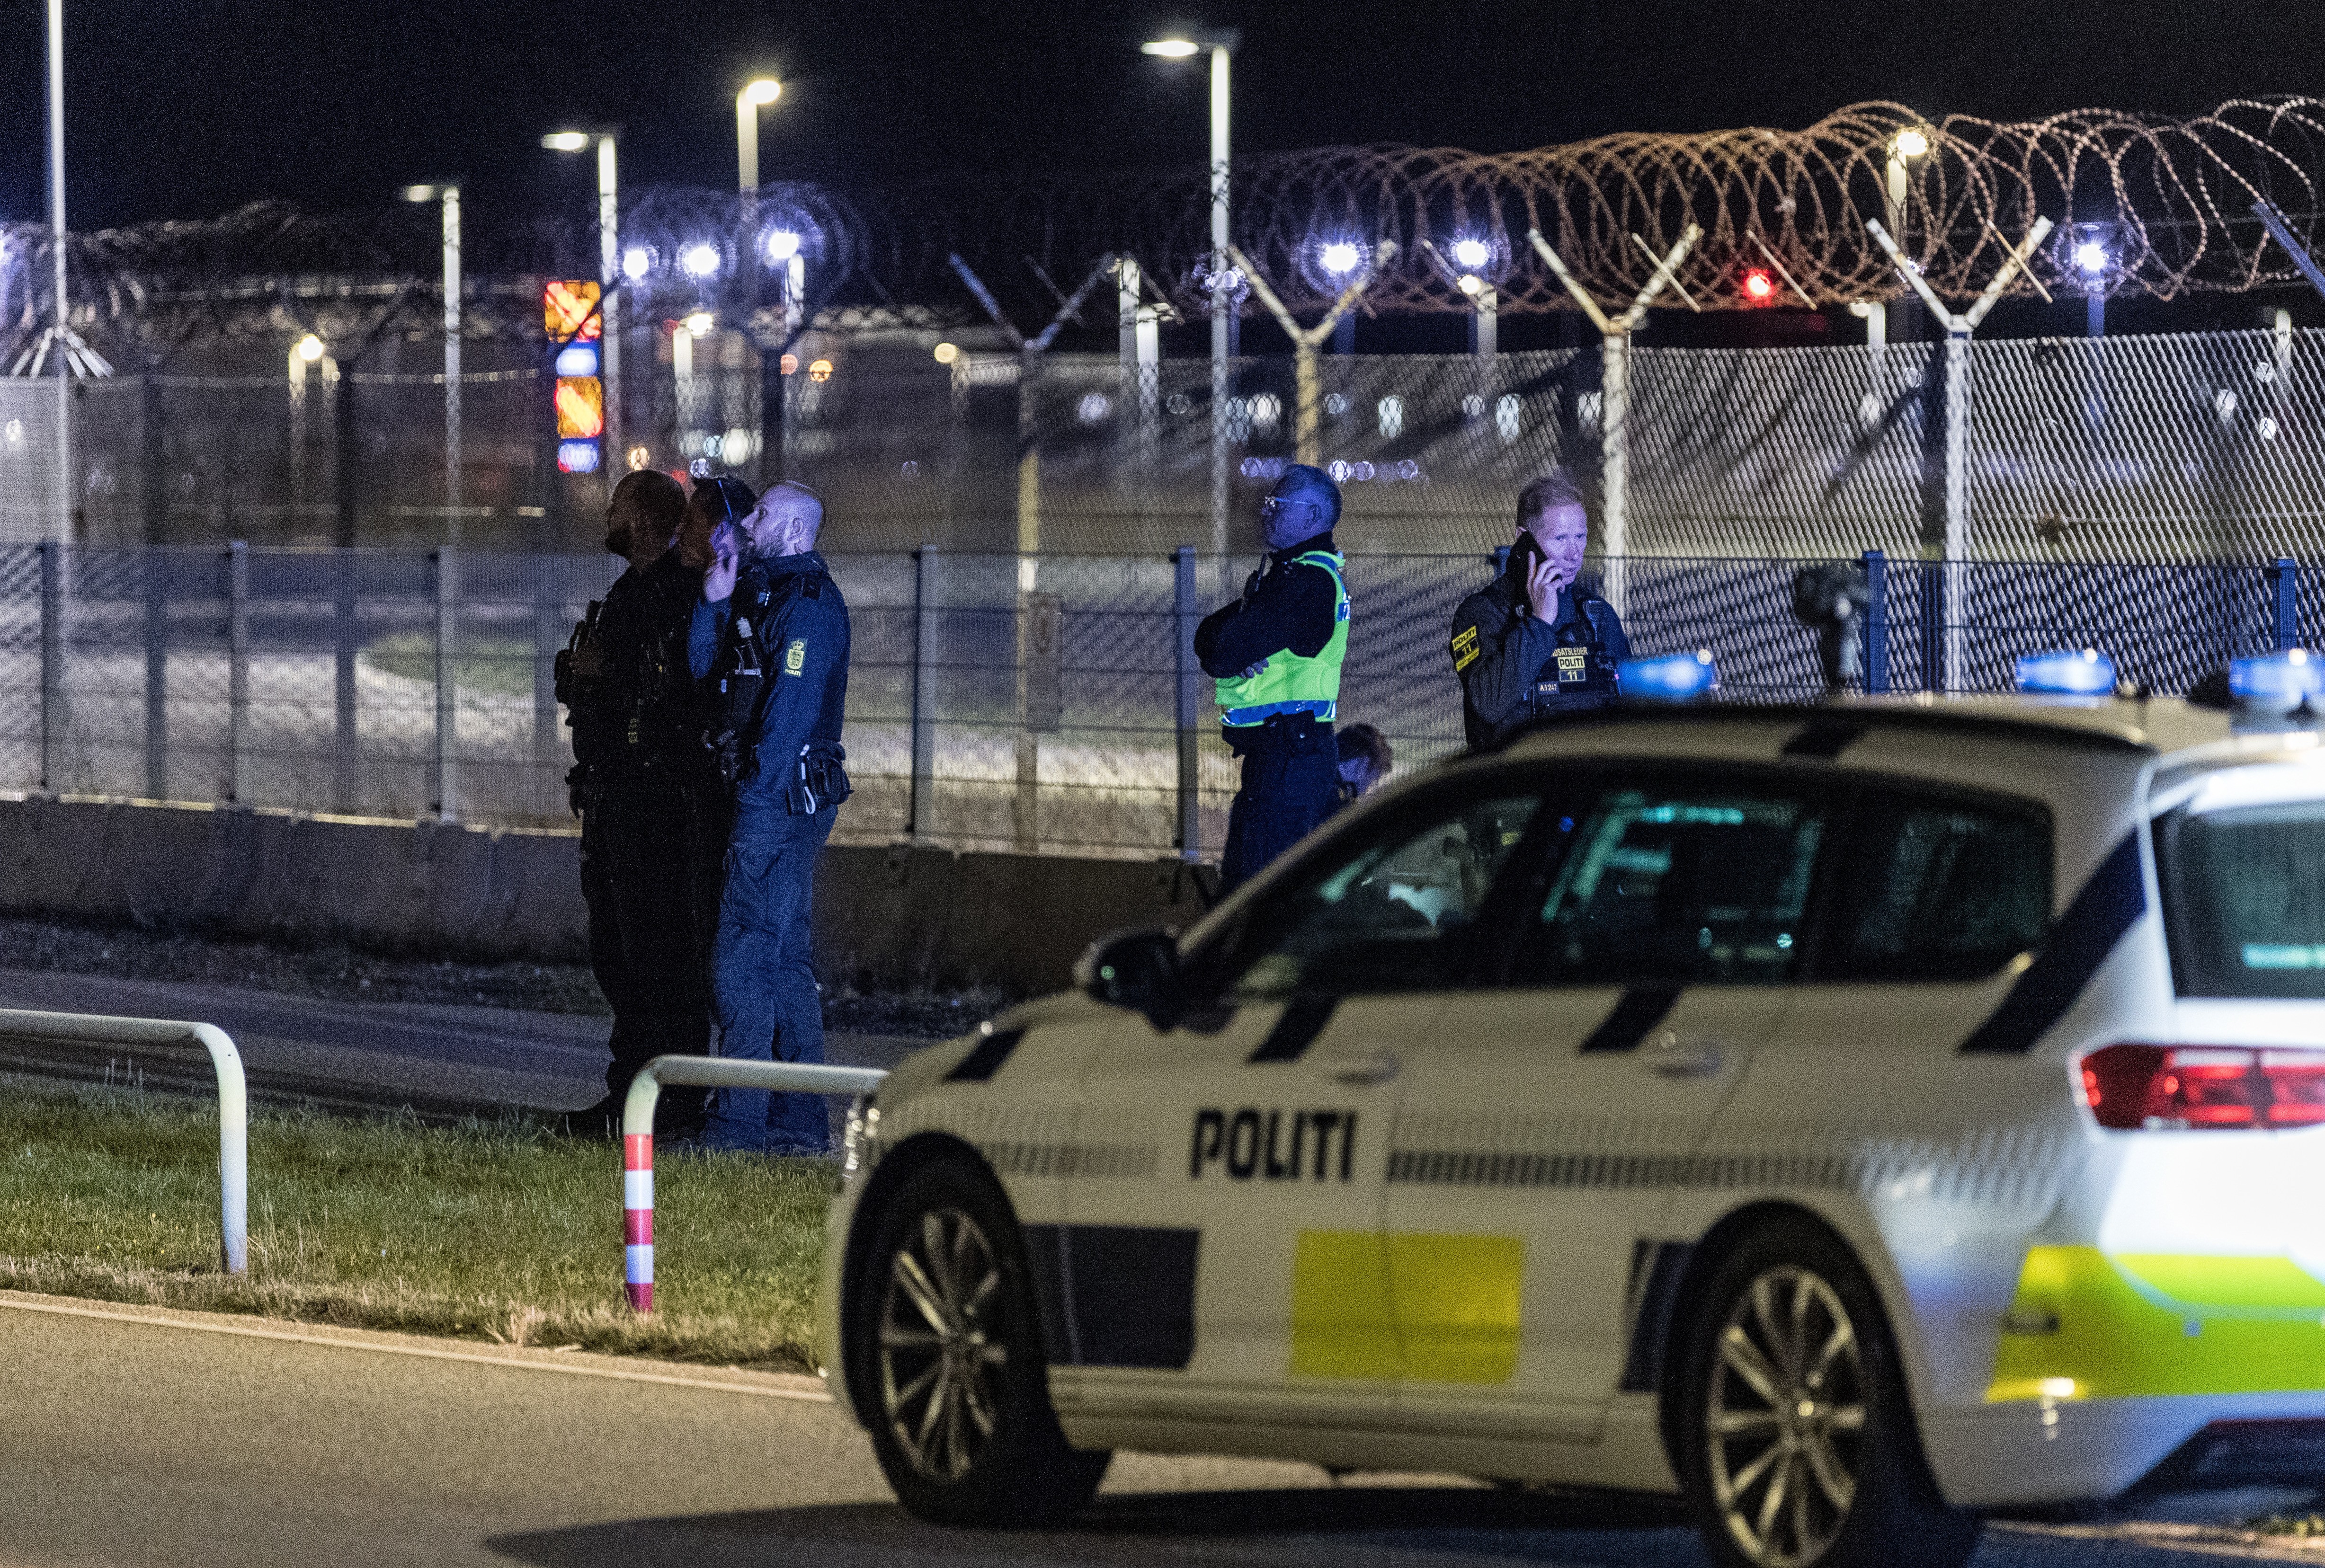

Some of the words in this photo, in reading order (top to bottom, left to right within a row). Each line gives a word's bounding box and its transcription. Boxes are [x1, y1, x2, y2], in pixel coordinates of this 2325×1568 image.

[1454, 629, 1475, 647] POLITI
[1462, 643, 1471, 655] 11
[1559, 658, 1583, 667] POLITI
[1567, 671, 1577, 680] 11
[1190, 1108, 1357, 1180] POLITI
